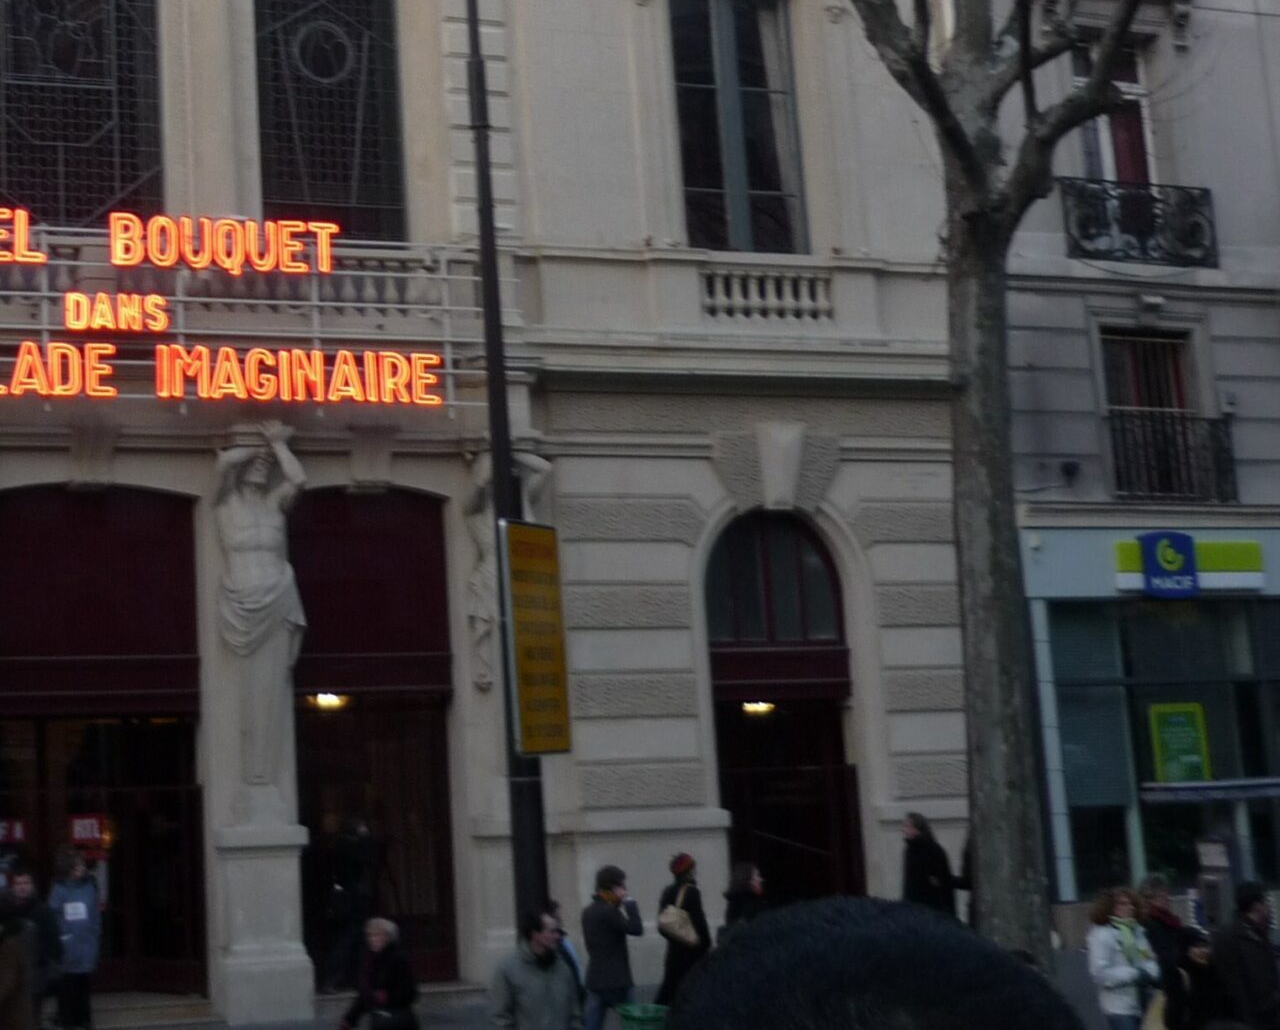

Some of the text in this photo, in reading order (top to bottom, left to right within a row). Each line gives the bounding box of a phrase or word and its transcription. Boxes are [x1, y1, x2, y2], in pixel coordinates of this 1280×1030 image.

[108, 210, 340, 275] BOUQUET
[64, 291, 170, 333] DANS
[154, 343, 445, 406] IMAGINAIRE
